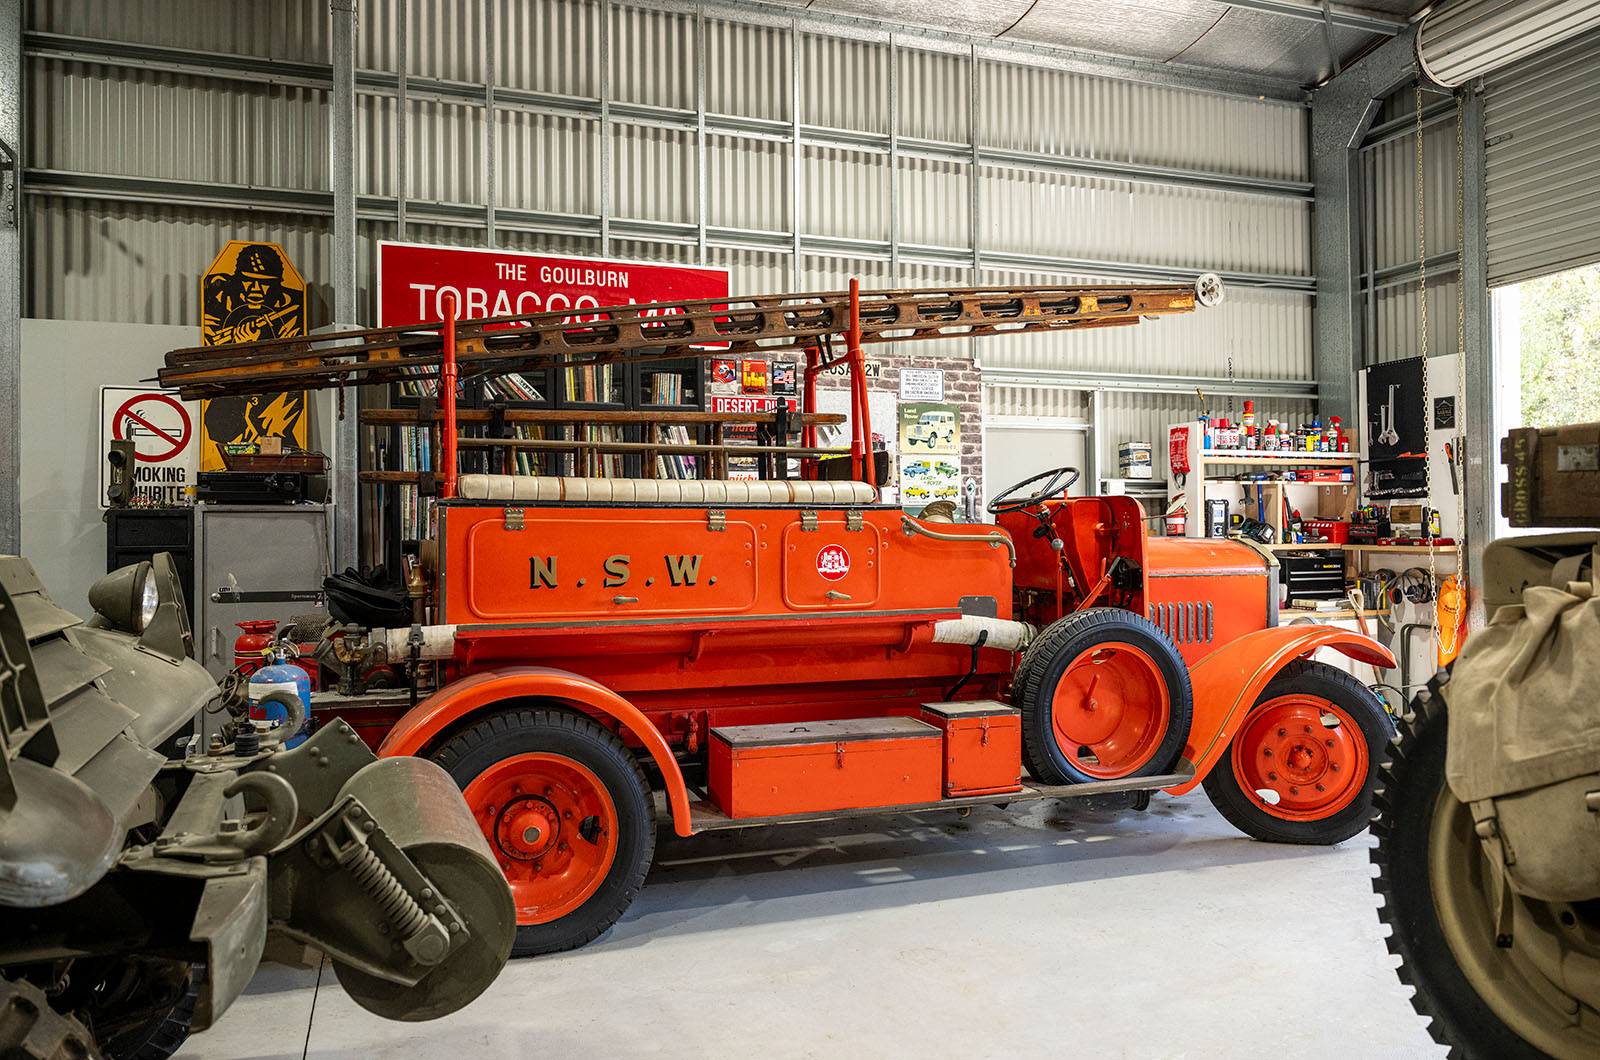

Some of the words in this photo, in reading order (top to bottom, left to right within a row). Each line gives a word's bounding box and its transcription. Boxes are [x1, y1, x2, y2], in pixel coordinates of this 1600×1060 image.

[496, 263, 527, 281] THE
[540, 265, 629, 289] GOULBURN
[409, 283, 600, 327] TOBACCO
[251, 396, 259, 406] 3
[716, 398, 759, 414] DESERT
